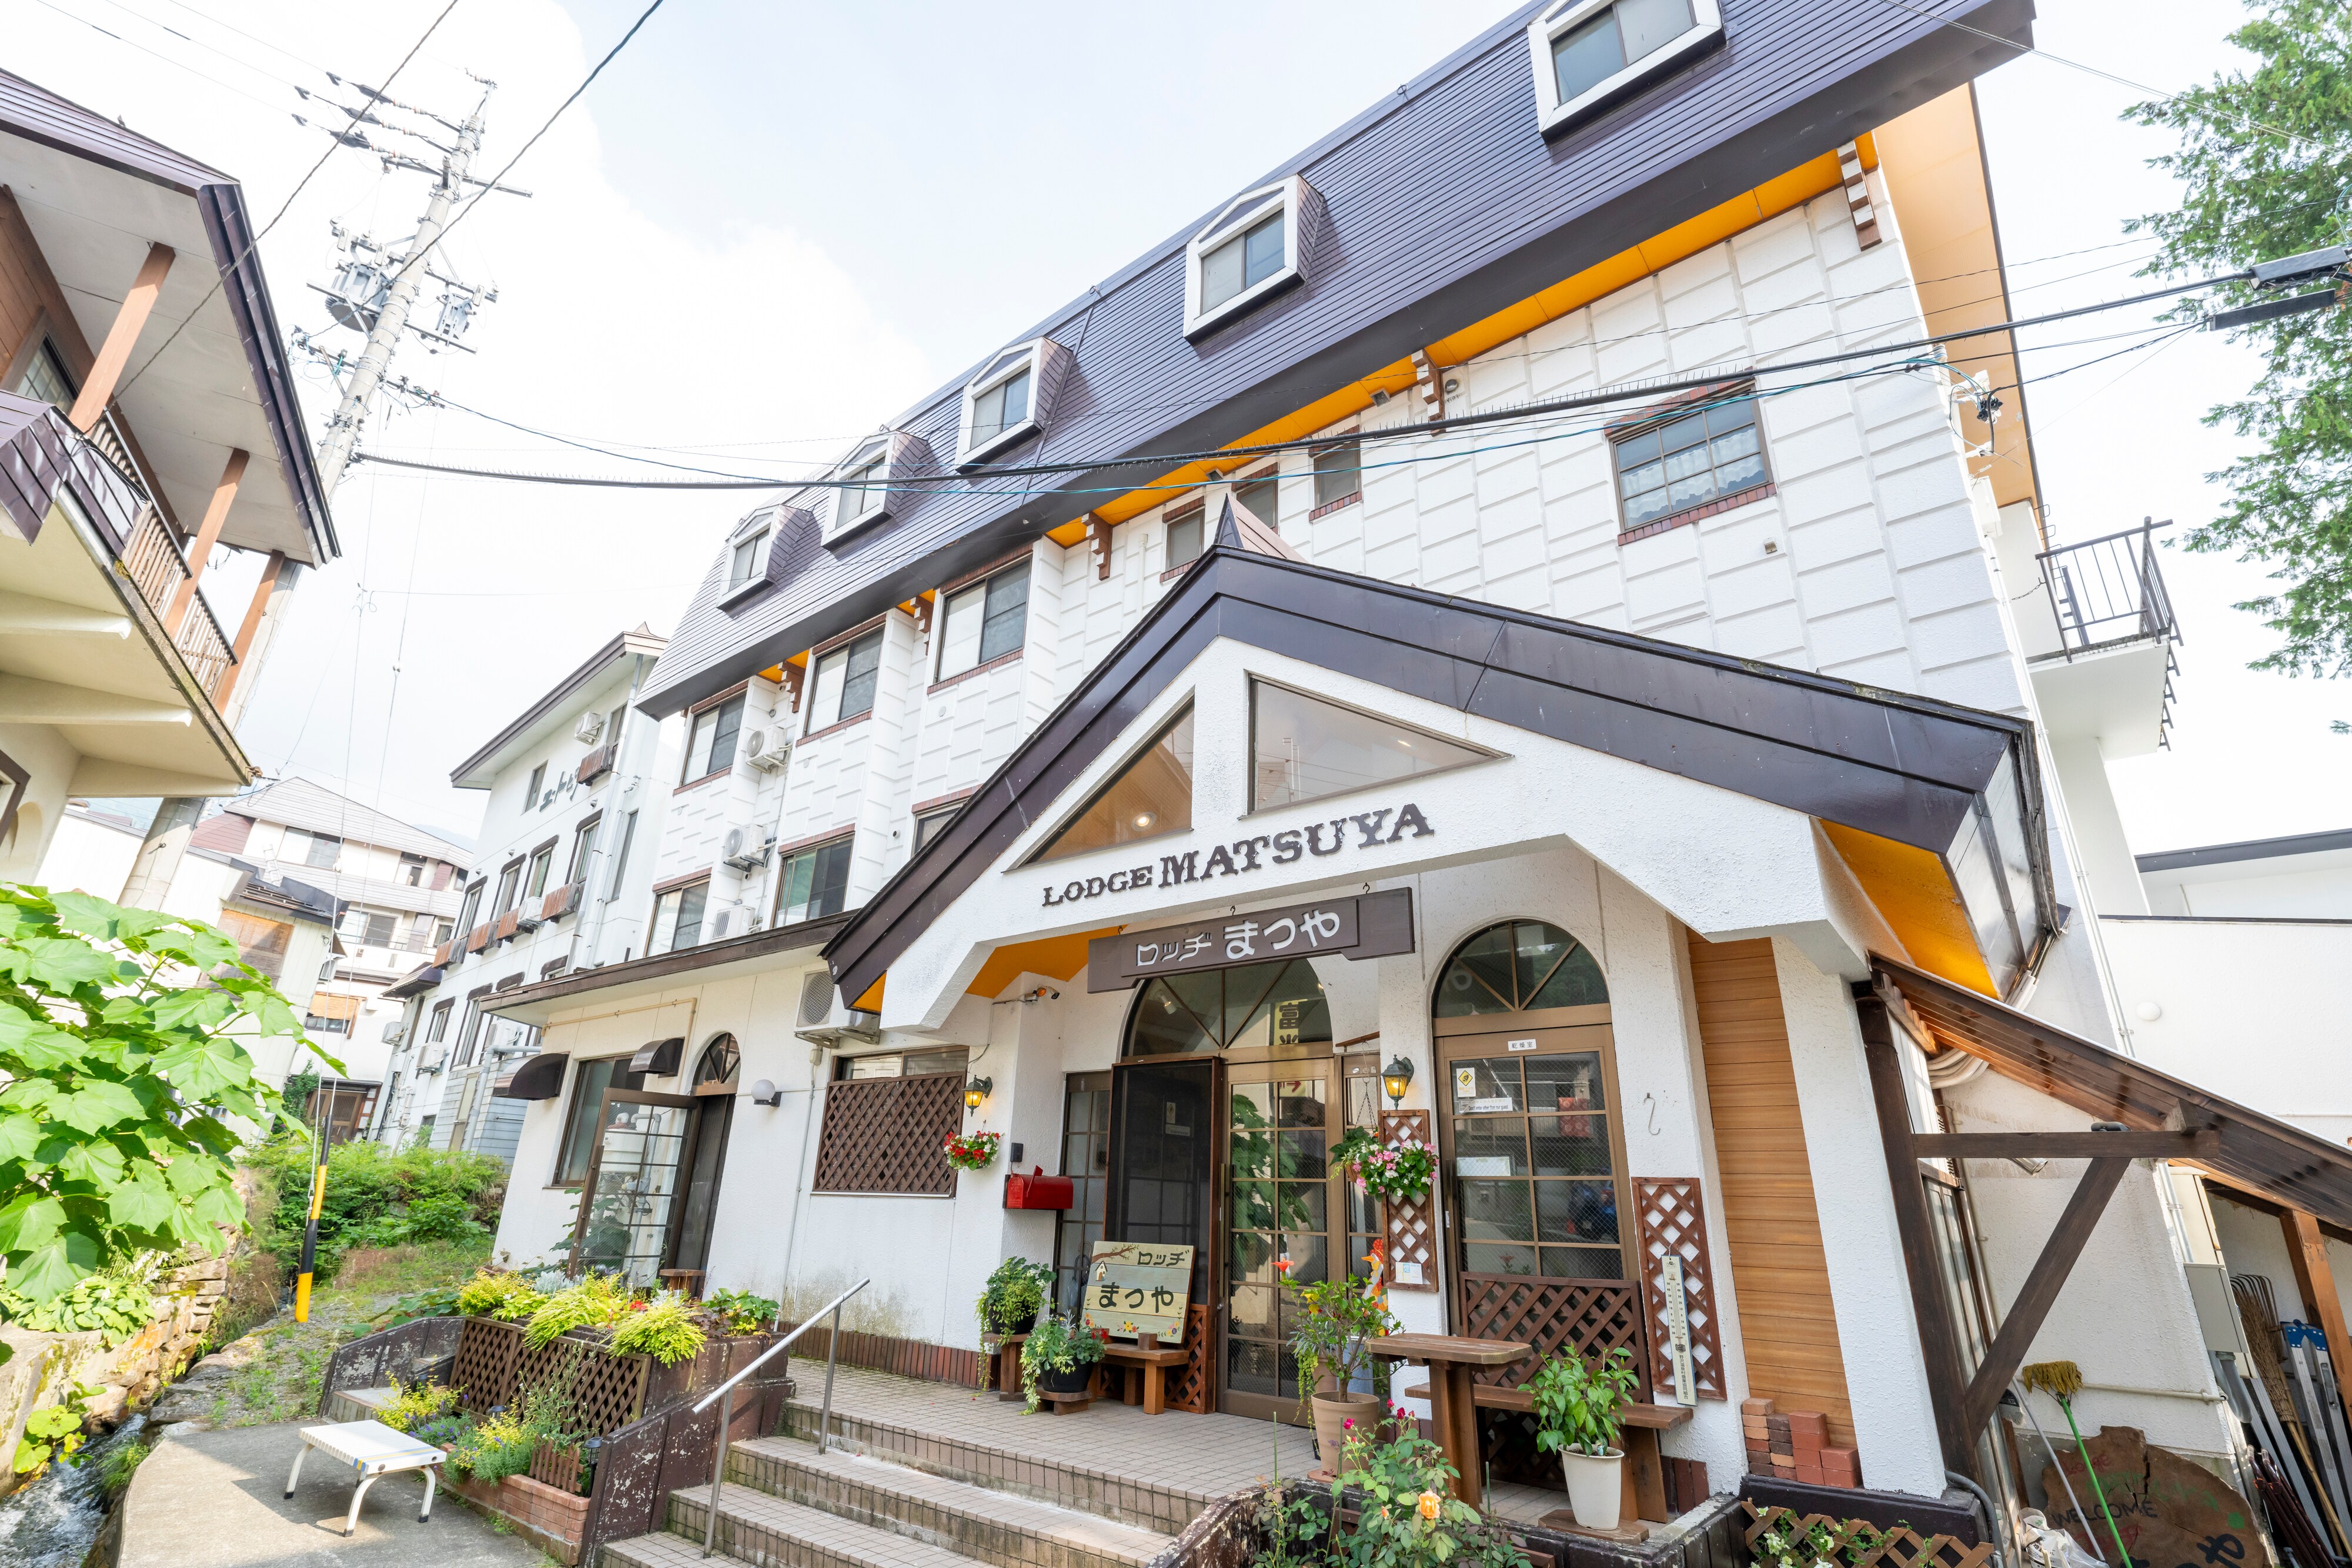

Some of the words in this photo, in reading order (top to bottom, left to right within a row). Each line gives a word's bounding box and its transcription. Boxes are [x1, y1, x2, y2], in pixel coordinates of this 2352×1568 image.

[1042, 865, 1153, 907] LODGE
[1158, 803, 1435, 888] MATSUYA
[1223, 908, 1340, 959] まつや
[1099, 1282, 1174, 1313] まつや
[2051, 1500, 2158, 1527] WELCOME
